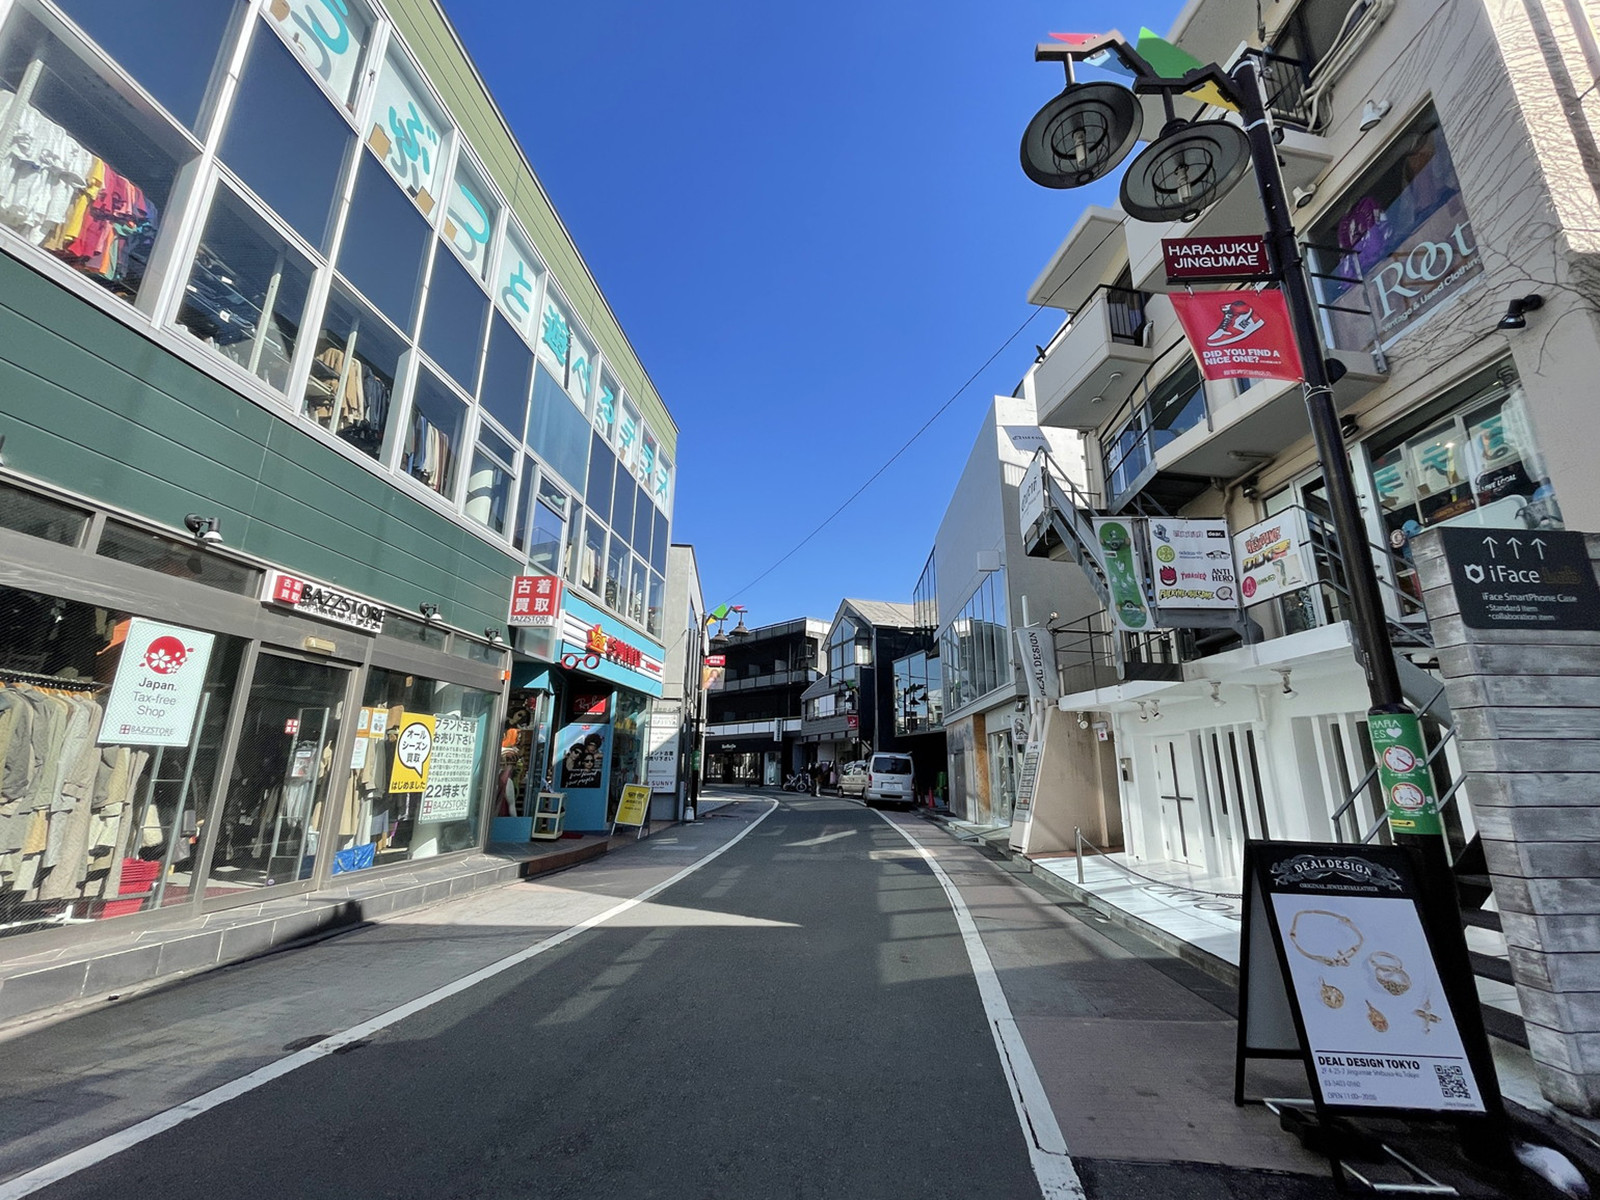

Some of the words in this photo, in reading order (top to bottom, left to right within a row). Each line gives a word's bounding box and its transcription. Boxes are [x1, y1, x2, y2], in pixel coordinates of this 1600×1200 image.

[1168, 242, 1259, 257] HARAJUKU
[1174, 254, 1259, 268] JINGUMAE
[1413, 300, 1420, 310] &
[1420, 283, 1444, 304] Used
[1203, 350, 1222, 358] DID
[1248, 349, 1271, 357] FIND
[1204, 356, 1231, 365] NICE
[1232, 356, 1259, 364] ONE?
[1212, 574, 1234, 582] HERO
[1489, 565, 1540, 584] iFace
[518, 579, 552, 594] 古着
[301, 583, 386, 624] BAZZSTORE
[1482, 592, 1503, 601] iFace
[515, 597, 549, 613] 買取
[510, 615, 549, 623] BAZZSTORE
[1028, 631, 1043, 667] DESIGN
[138, 677, 177, 692] Japan.
[133, 691, 177, 705] Tax-free
[136, 705, 165, 718] Shop
[131, 725, 174, 736] BAZZSTORE
[407, 730, 426, 740] オール
[433, 732, 475, 745] お売り下さい
[402, 741, 427, 751] シーズン
[406, 753, 421, 763] 買取
[392, 781, 425, 790] はじめました
[425, 783, 468, 798] 22時まで
[1294, 860, 1326, 873] DEAL
[1326, 859, 1372, 876] DESIGN
[1318, 1056, 1344, 1067] DEAL
[1346, 1057, 1383, 1068] DESIGN
[1385, 1059, 1420, 1070] TOKYO
